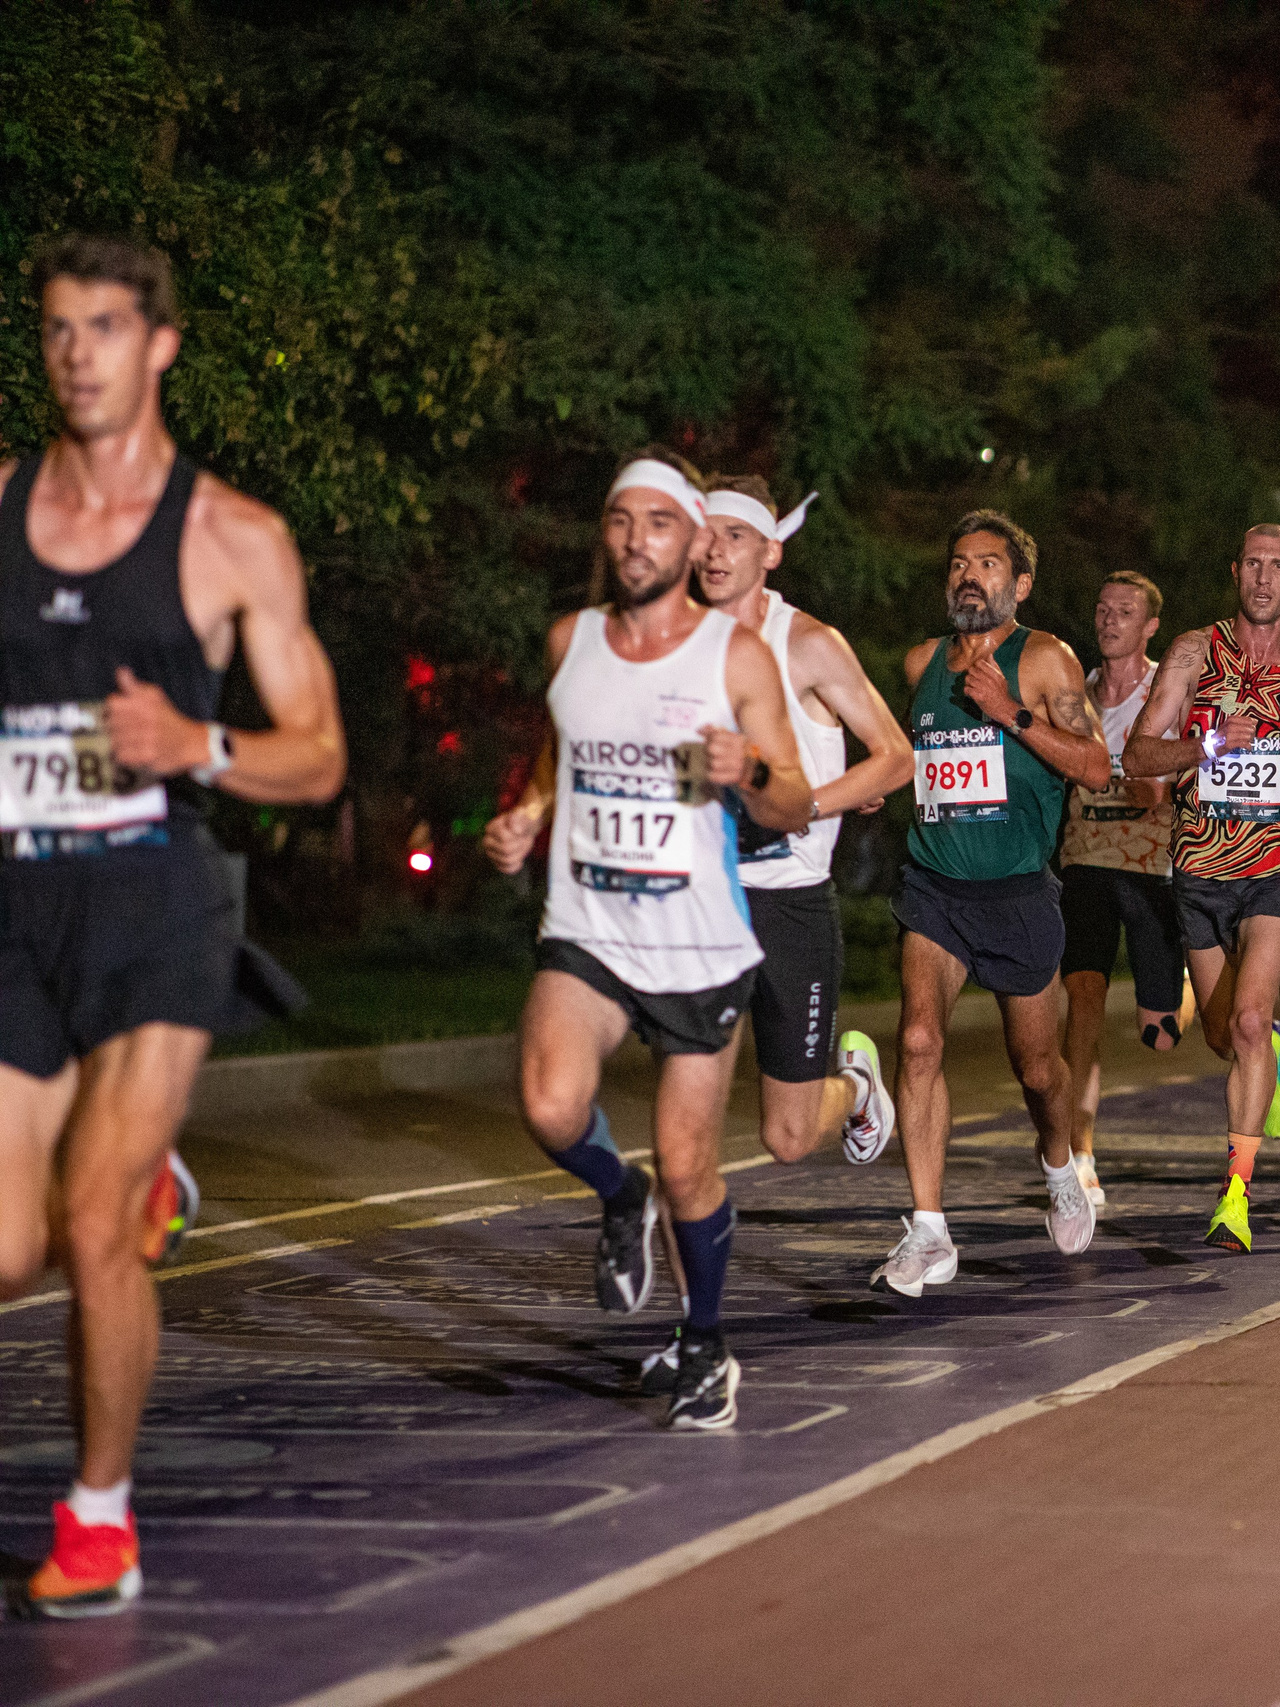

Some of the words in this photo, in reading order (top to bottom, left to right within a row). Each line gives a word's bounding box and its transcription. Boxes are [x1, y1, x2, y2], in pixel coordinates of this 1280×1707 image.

[925, 759, 988, 791] 9891
[1210, 761, 1277, 788] 5232
[589, 806, 675, 848] 1117
